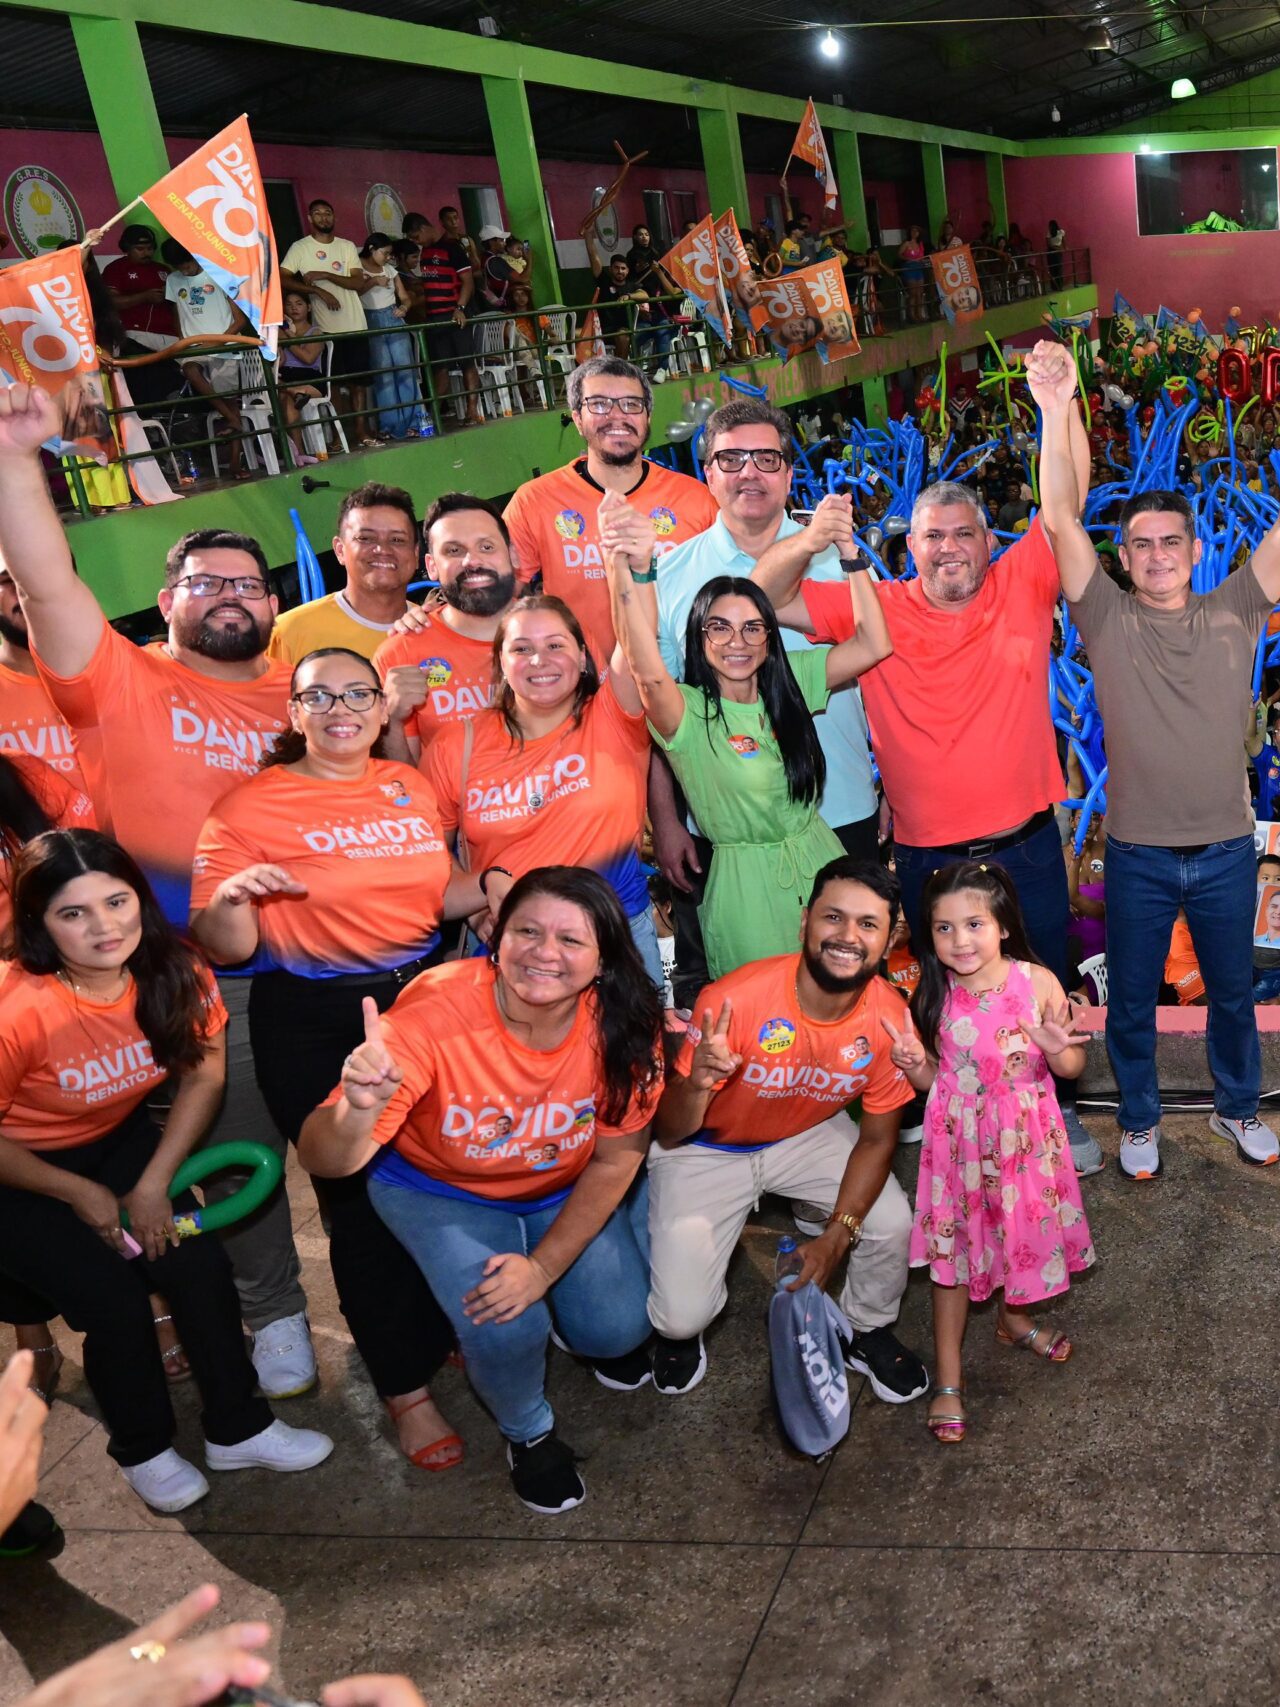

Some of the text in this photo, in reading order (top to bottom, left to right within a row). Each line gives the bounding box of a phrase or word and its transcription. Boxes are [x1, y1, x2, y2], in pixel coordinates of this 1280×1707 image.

[185, 158, 260, 248] 70
[166, 191, 237, 264] RENATO JUNIOR
[719, 225, 750, 266] DAVID
[761, 283, 794, 319] 70
[784, 282, 807, 317] DAVID
[806, 272, 832, 314] 70
[822, 268, 844, 308] DAVID
[0, 283, 80, 373] 70
[42, 274, 95, 364] DAVID
[431, 685, 492, 717] DAV
[544, 776, 592, 803] UNIOR
[344, 844, 404, 860] RENATO
[767, 1039, 791, 1051] 27123
[85, 1070, 149, 1105] RENATO
[757, 1085, 809, 1100] RENATO
